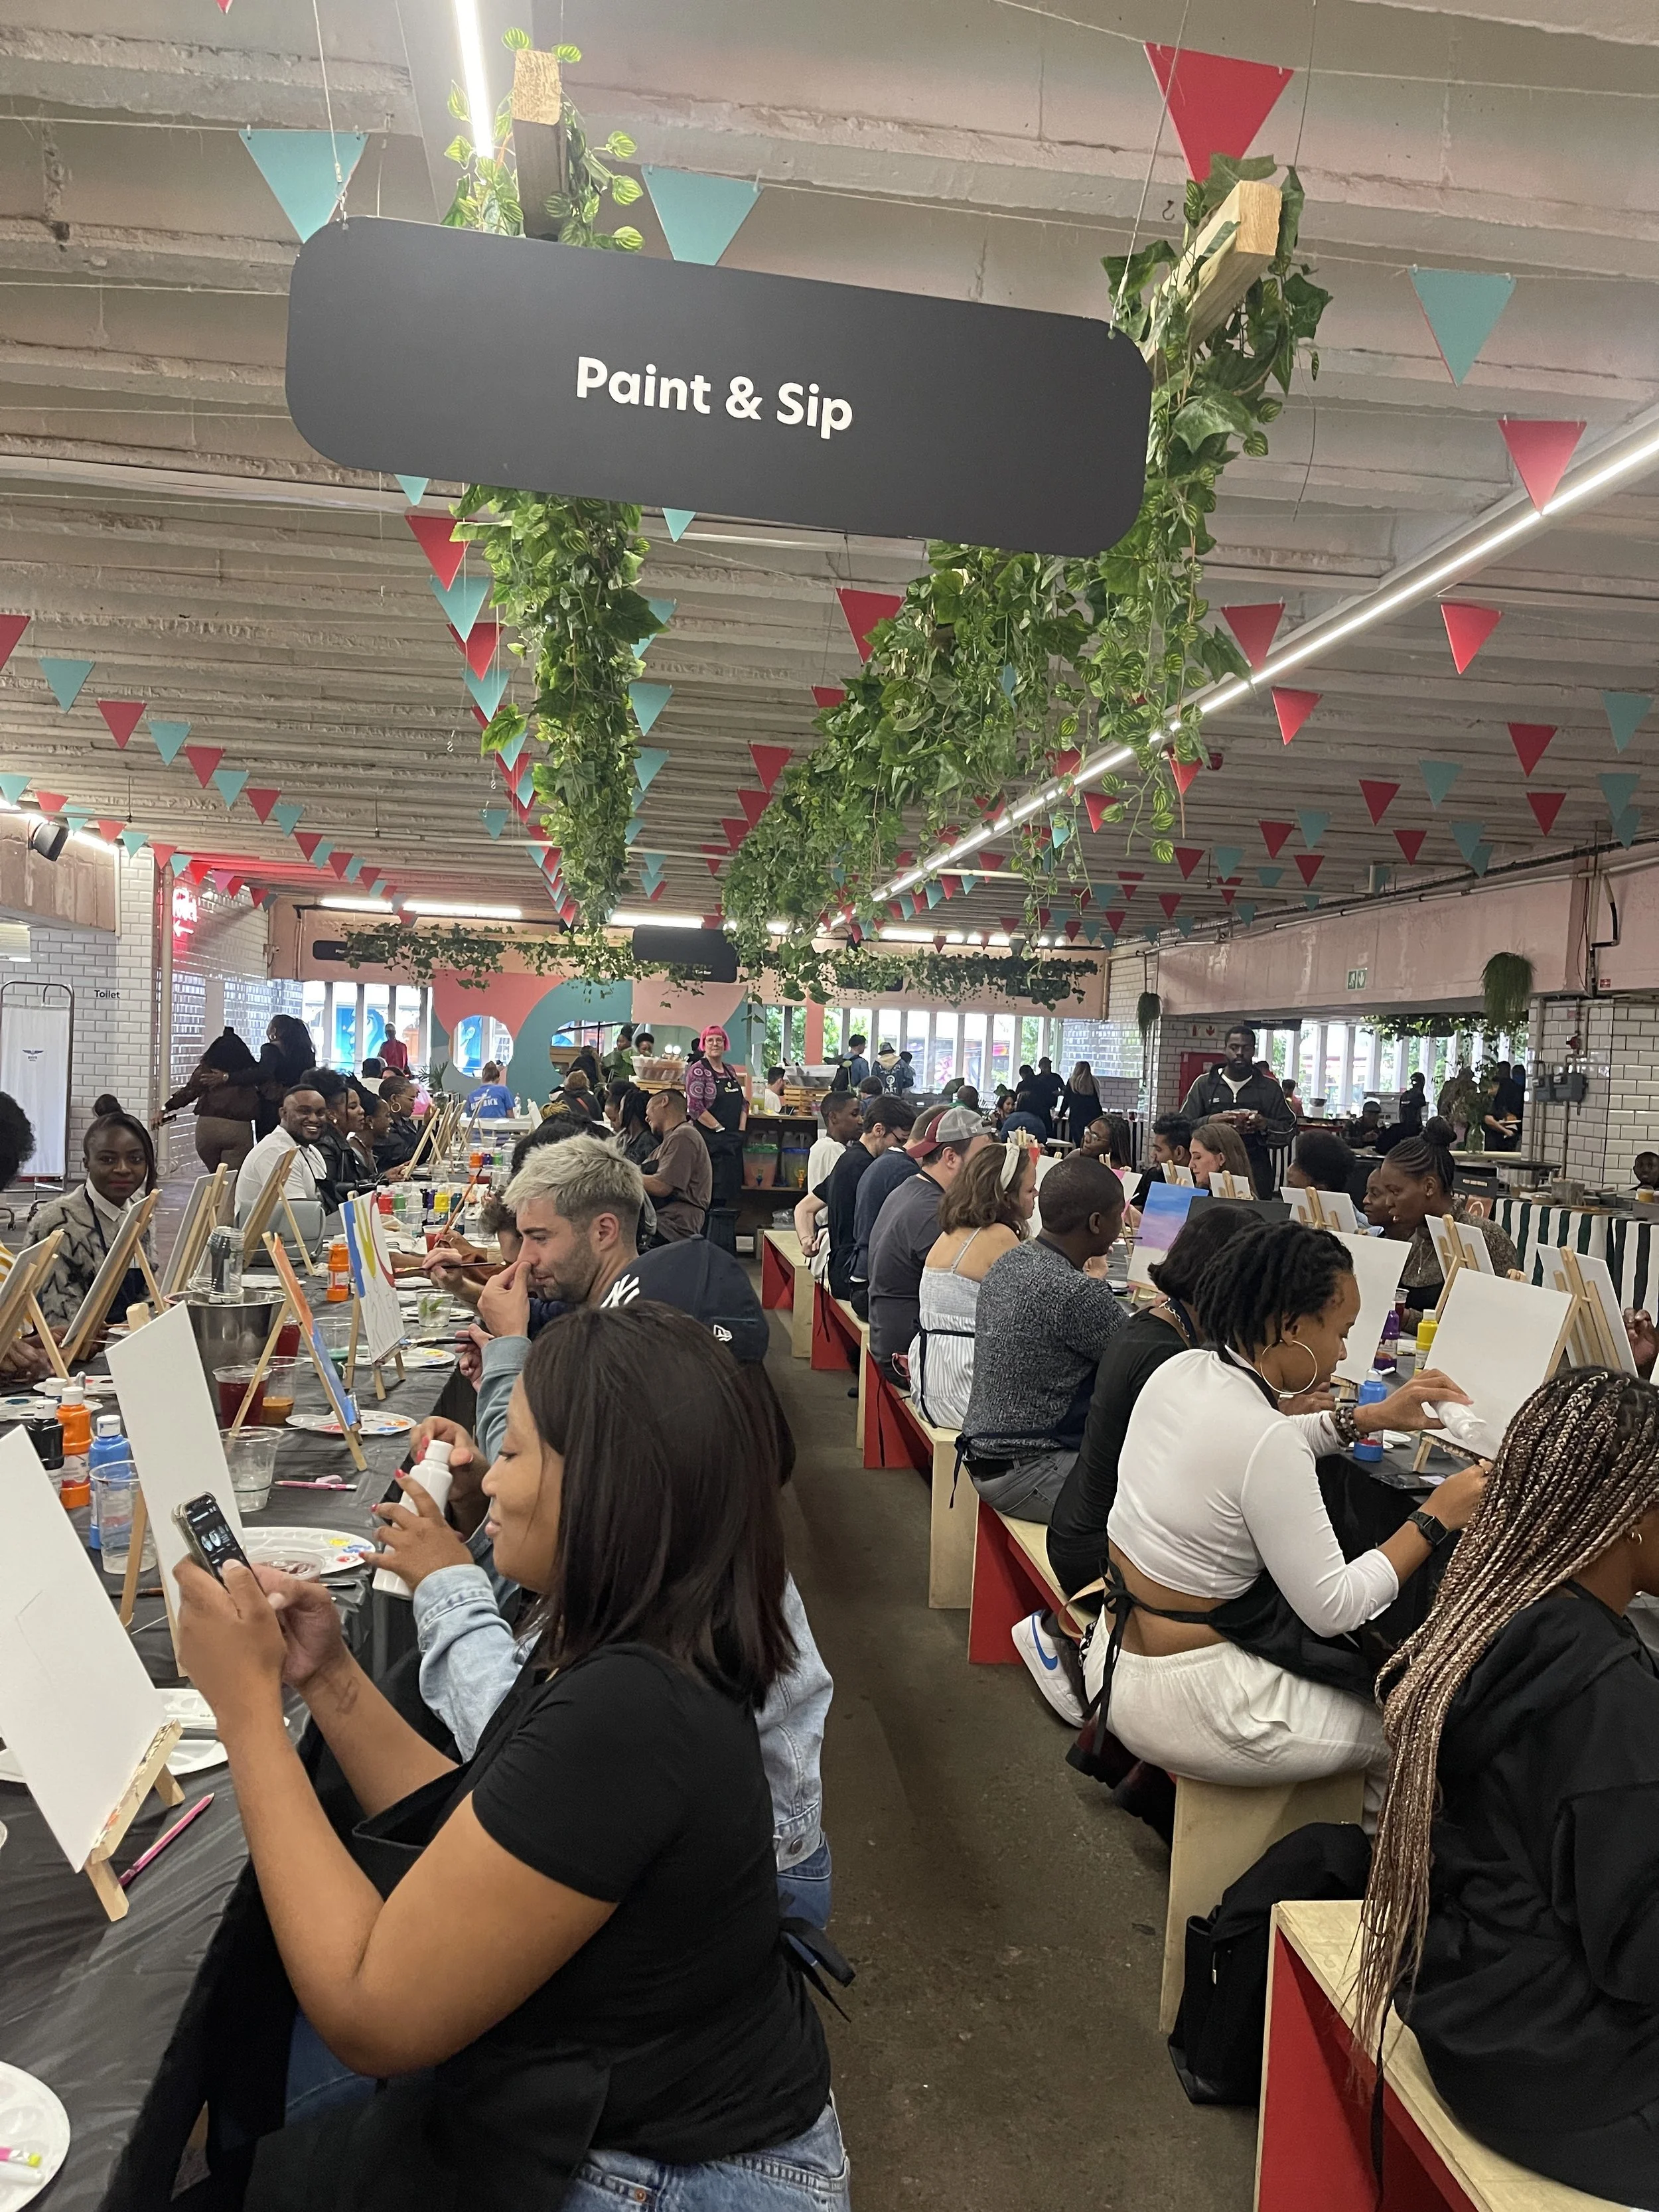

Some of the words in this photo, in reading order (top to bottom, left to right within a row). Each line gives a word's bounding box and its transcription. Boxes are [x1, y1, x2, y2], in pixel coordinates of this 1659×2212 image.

[576, 356, 711, 415] Paint
[725, 376, 762, 420] &
[776, 382, 853, 440] Sip
[94, 990, 121, 999] Toilet
[600, 1274, 640, 1308] NY
